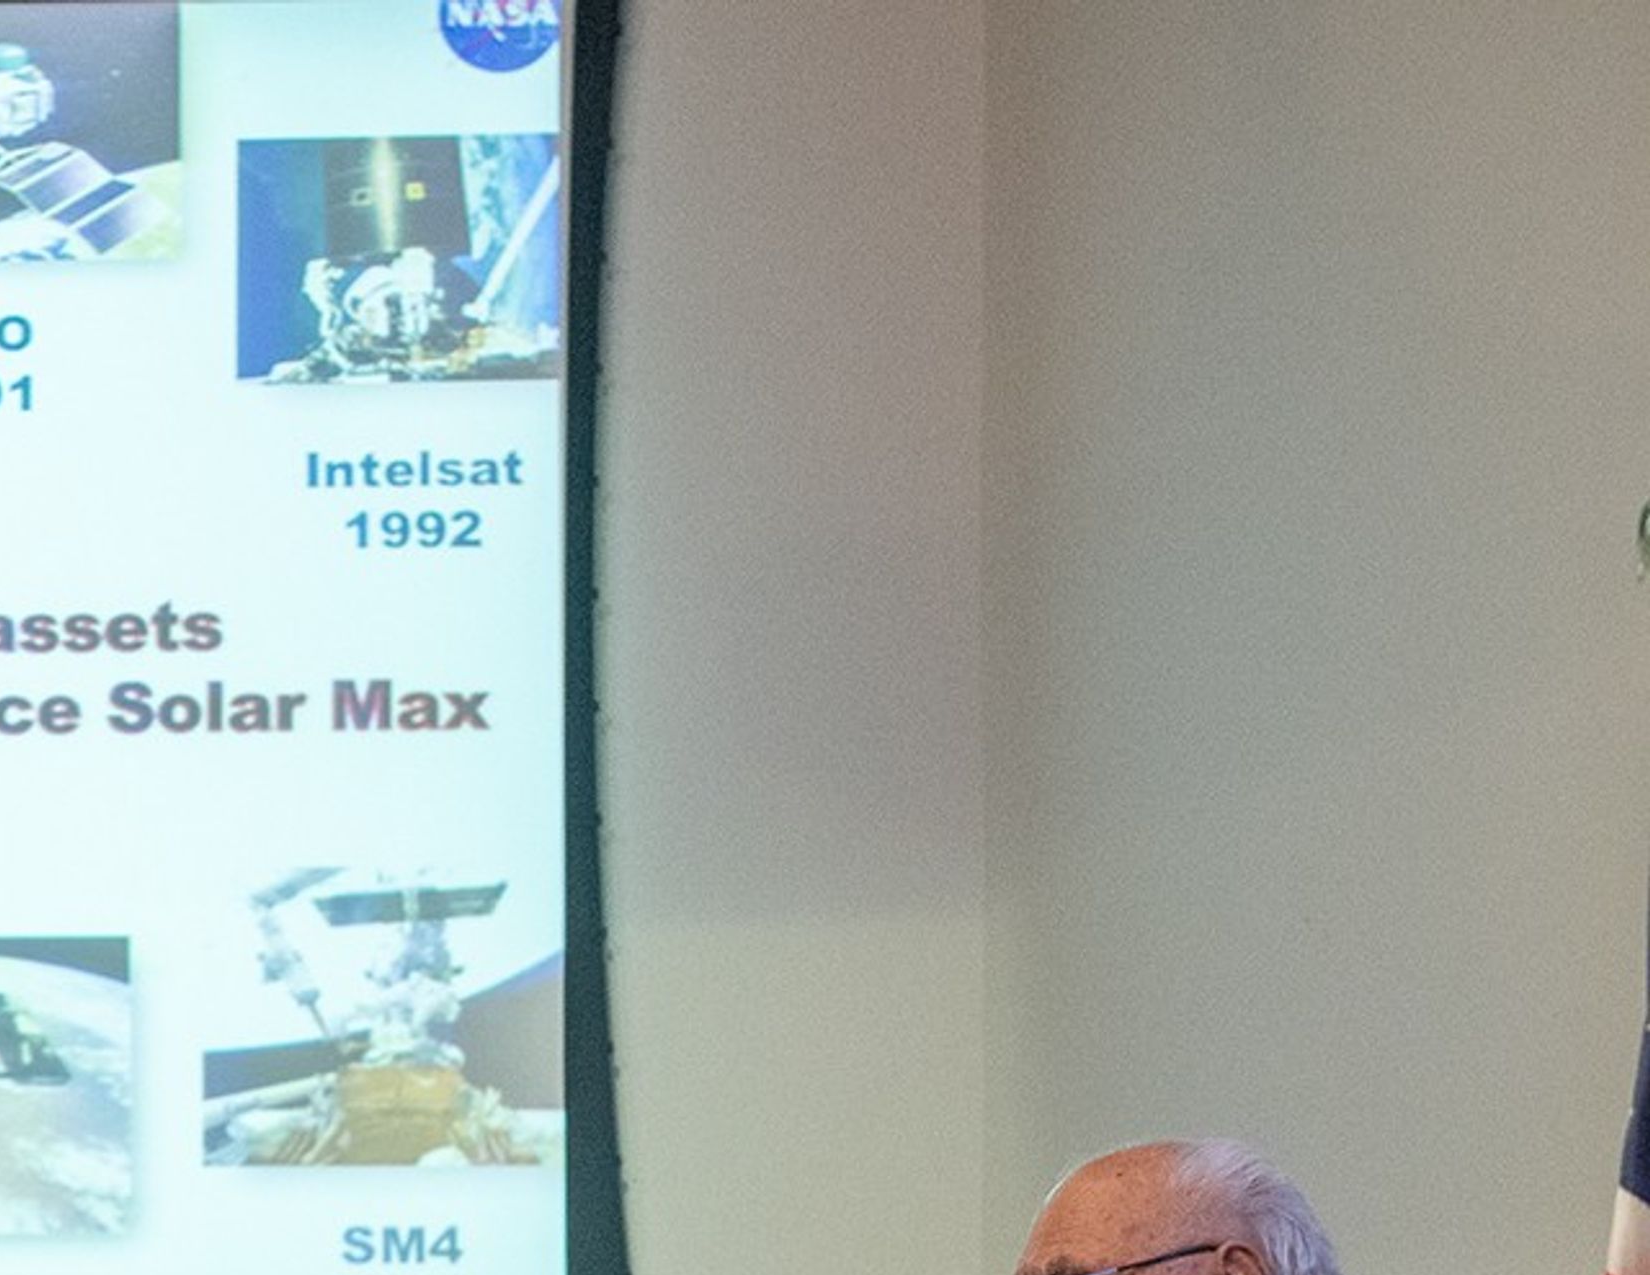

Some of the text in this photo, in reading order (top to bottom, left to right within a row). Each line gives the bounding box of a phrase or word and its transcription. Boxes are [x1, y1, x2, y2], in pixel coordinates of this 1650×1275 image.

[446, 0, 559, 27] NASA
[307, 451, 523, 488] Intelsat
[347, 509, 482, 549] 1992
[108, 680, 307, 733] Solar
[333, 678, 490, 731] Max
[343, 1226, 463, 1264] SM4
